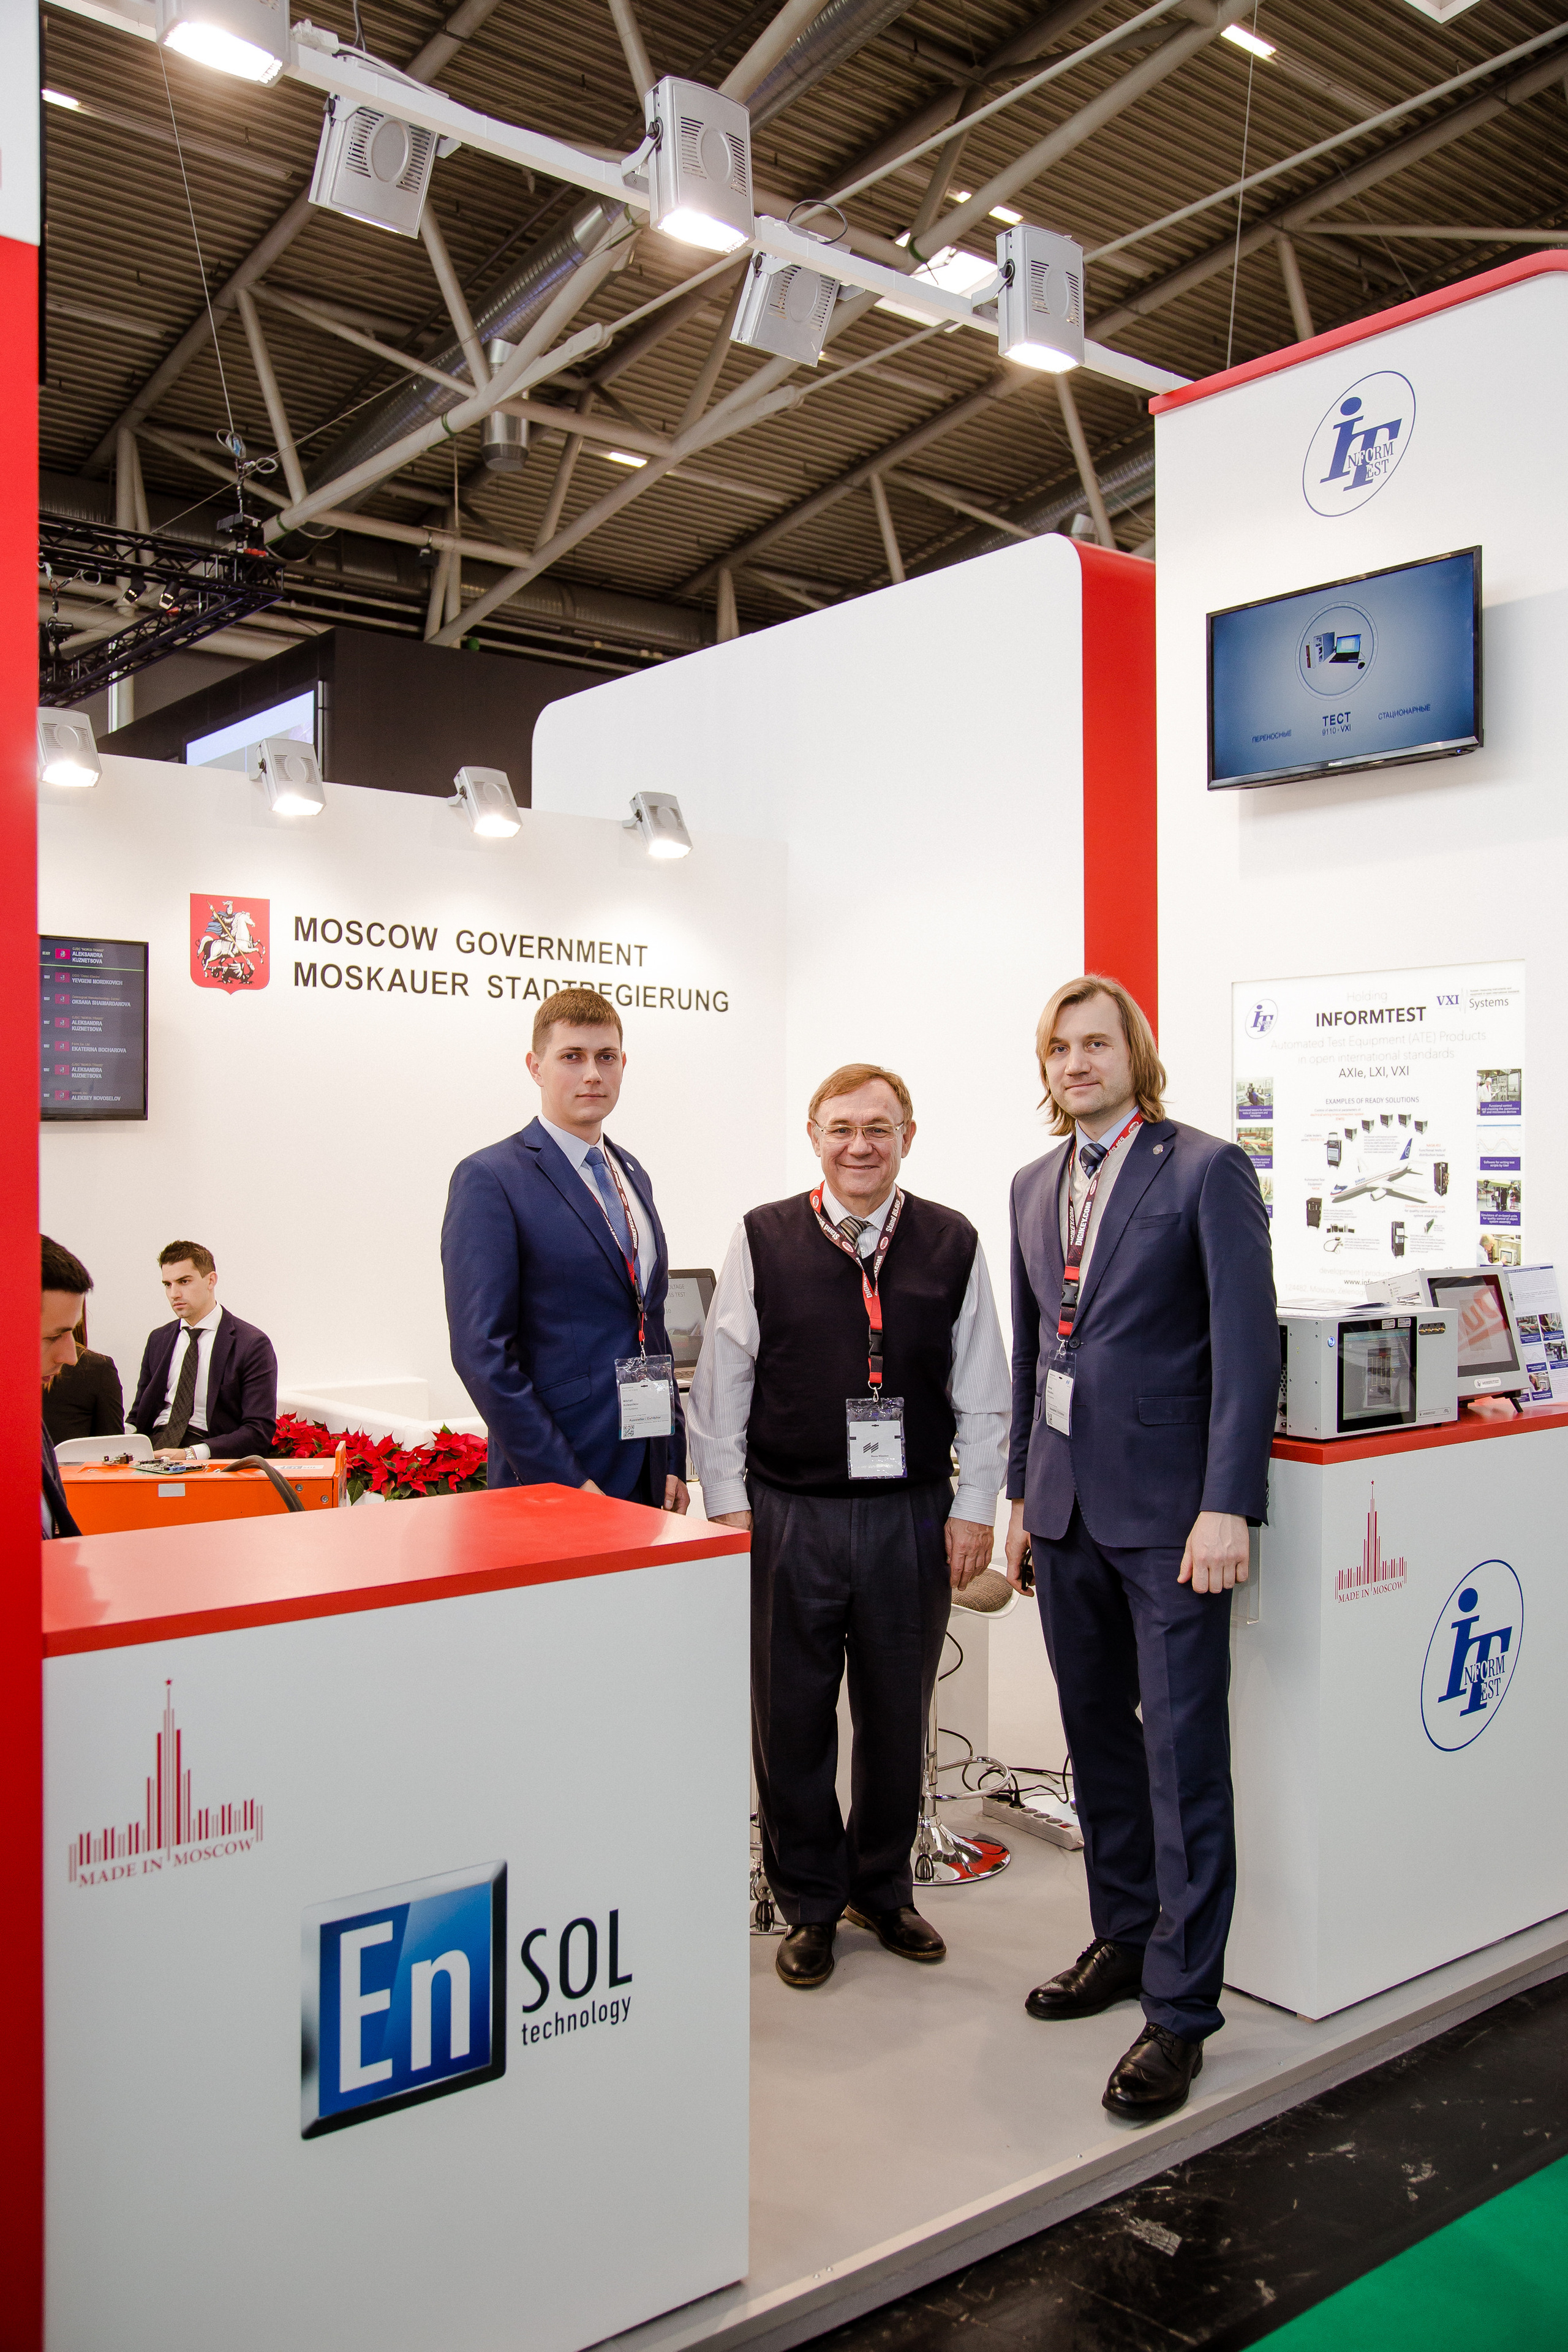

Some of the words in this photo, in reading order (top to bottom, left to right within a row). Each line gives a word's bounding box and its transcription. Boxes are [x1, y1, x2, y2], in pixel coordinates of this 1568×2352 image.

[294, 916, 439, 951] MOSCOW
[456, 929, 648, 967] GOVERNMENT
[294, 961, 470, 997] MOSKAUER
[487, 974, 729, 1012] STADEGIERUNG
[1347, 990, 1387, 1003] Holding
[1436, 995, 1459, 1005] VXI
[1469, 998, 1509, 1011] Systems
[1316, 1006, 1427, 1027] INFORMTEST
[1270, 1038, 1324, 1050] Automated
[1327, 1036, 1346, 1047] Test
[1349, 1035, 1406, 1049] Equipment
[1409, 1031, 1436, 1045] (ATE)
[1439, 1029, 1487, 1042] Products
[1309, 1055, 1335, 1066] open
[1338, 1050, 1400, 1063] international
[1403, 1047, 1455, 1060] standards
[1369, 1066, 1389, 1078] LXI,
[1391, 1066, 1409, 1076] VXI
[823, 1224, 840, 1240] Stand
[886, 1215, 897, 1232] Stand
[1074, 1201, 1092, 1246] DIGIKEY.COM
[1338, 1590, 1360, 1604] MADE
[1361, 1588, 1370, 1599] IN
[1373, 1580, 1404, 1596] MOSCOW
[78, 1863, 137, 1888] MADE
[143, 1856, 164, 1874] IN
[173, 1838, 254, 1868] MOSCOW
[521, 1996, 632, 2046] technology
